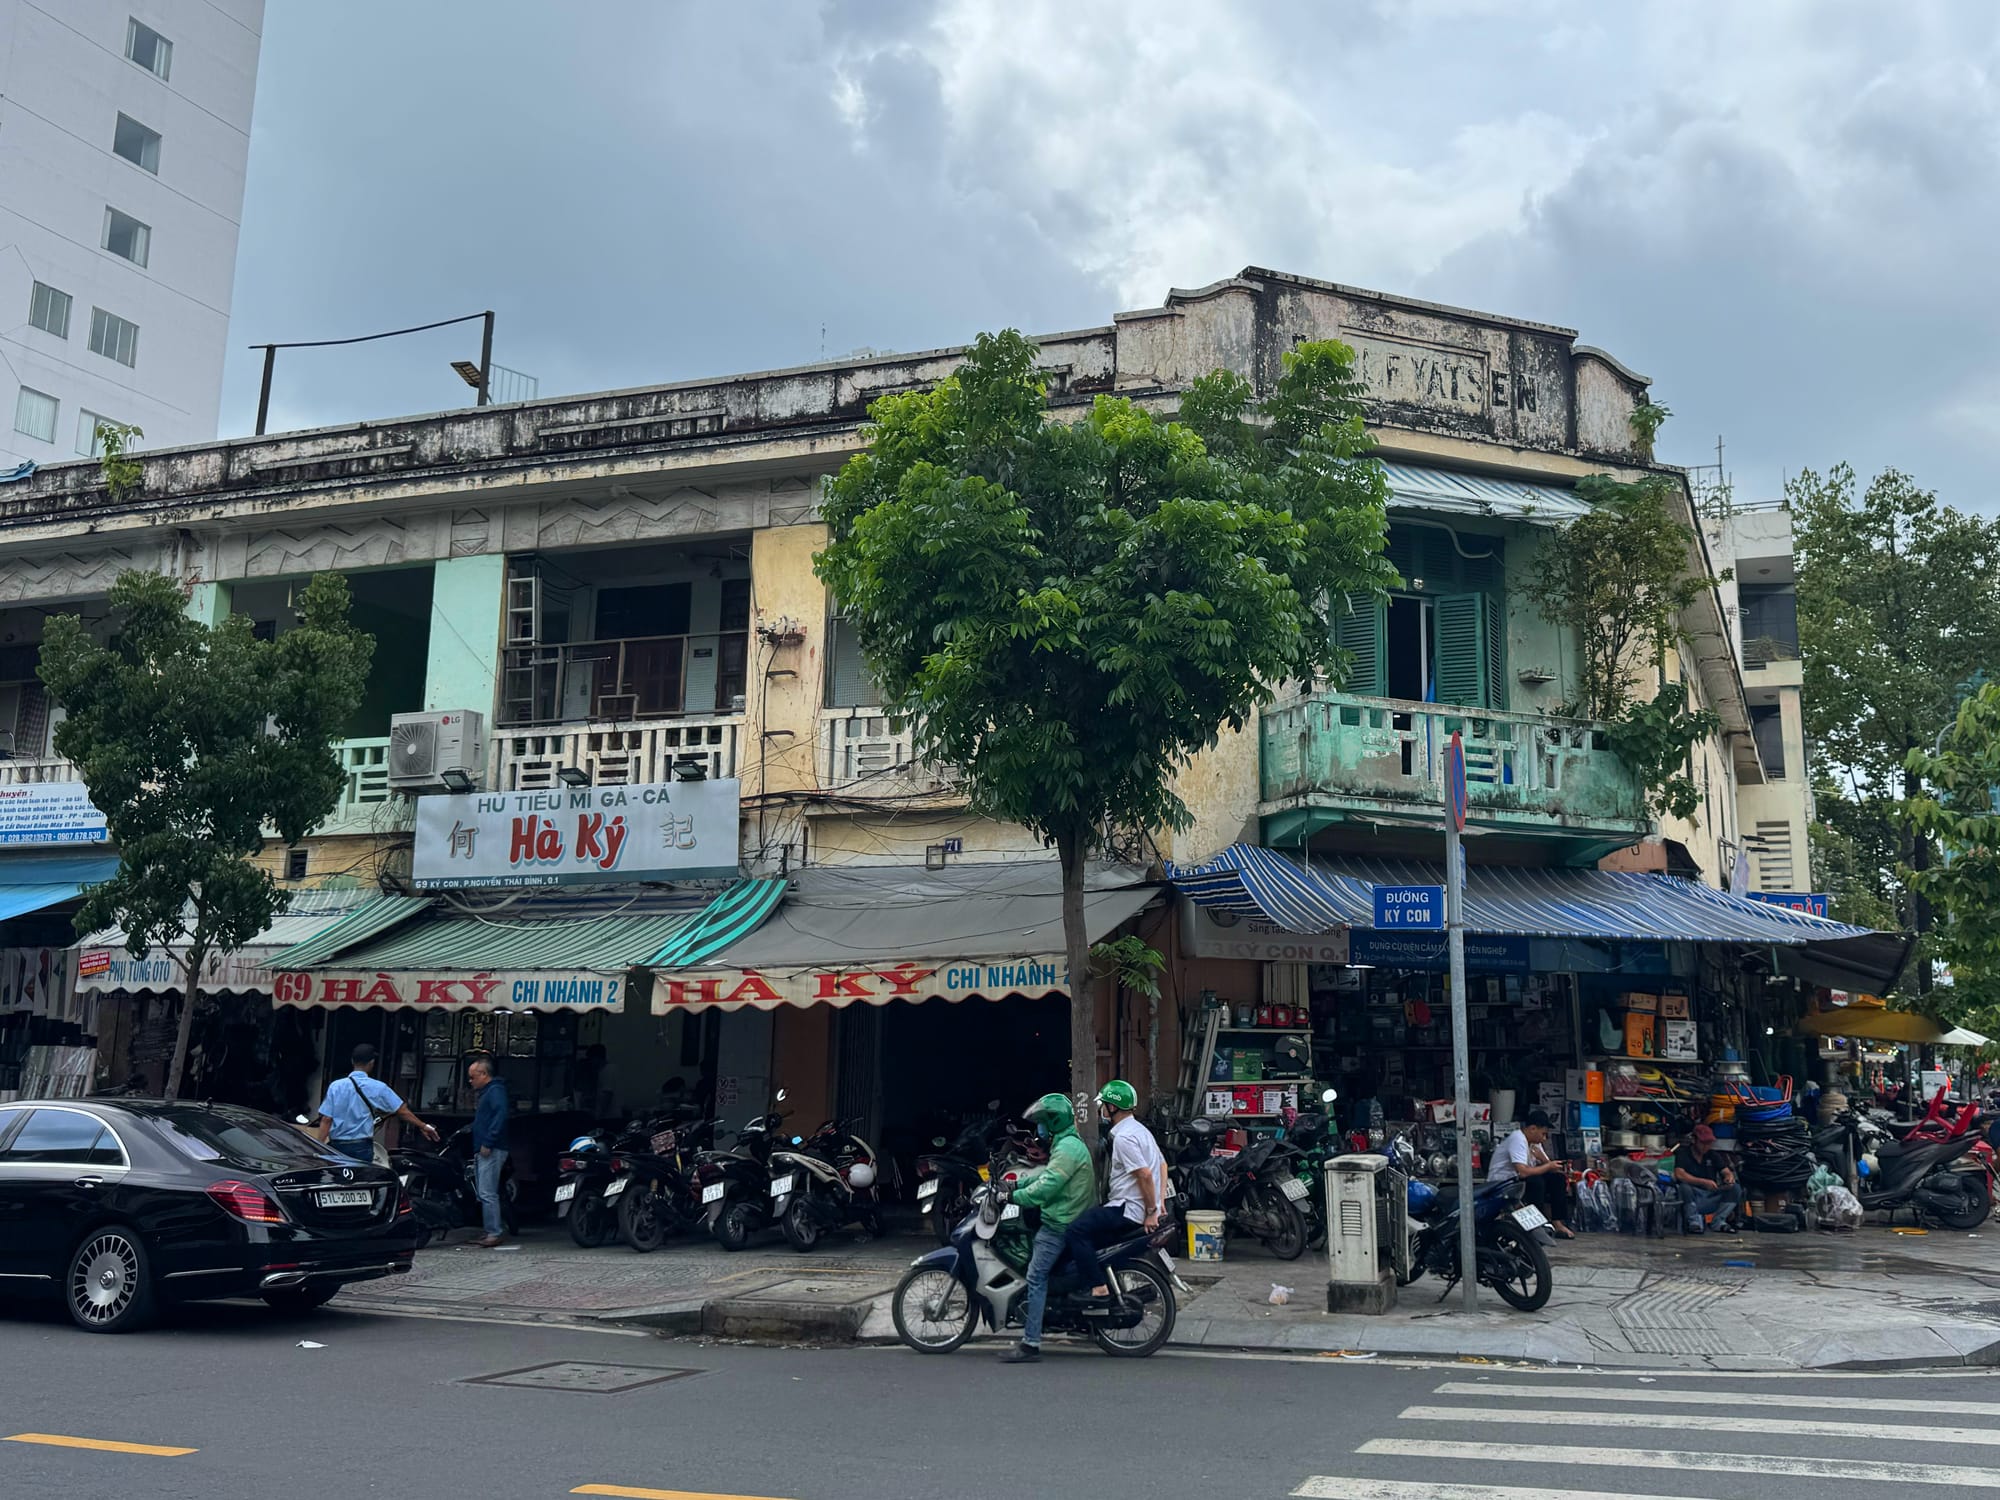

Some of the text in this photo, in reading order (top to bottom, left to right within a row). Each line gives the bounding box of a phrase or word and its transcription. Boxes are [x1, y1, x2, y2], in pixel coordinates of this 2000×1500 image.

[451, 716, 461, 724] LG
[601, 787, 627, 807] GÀ
[643, 784, 670, 804] CÁ
[447, 820, 479, 859] 何
[659, 812, 696, 850] 記
[510, 812, 625, 869] Hà Ký
[946, 839, 958, 851] 71
[415, 880, 428, 889] 69
[1386, 890, 1429, 903] ĐƯỜNG
[1384, 905, 1431, 922] KÝ CON
[1248, 922, 1269, 935] Sáng
[1232, 941, 1259, 957] KÝ
[1266, 944, 1313, 960] CON
[1320, 946, 1348, 961] Q.1
[274, 972, 619, 1004] 69 HÀ KÝ CHI NHÁNH 2
[663, 968, 783, 1004] HÀ
[813, 962, 935, 999] KÝ
[946, 967, 981, 990] CHI
[987, 962, 1056, 988] NHÁNH
[1106, 1091, 1122, 1101] Grab
[321, 1192, 368, 1205] 51L-200.30
